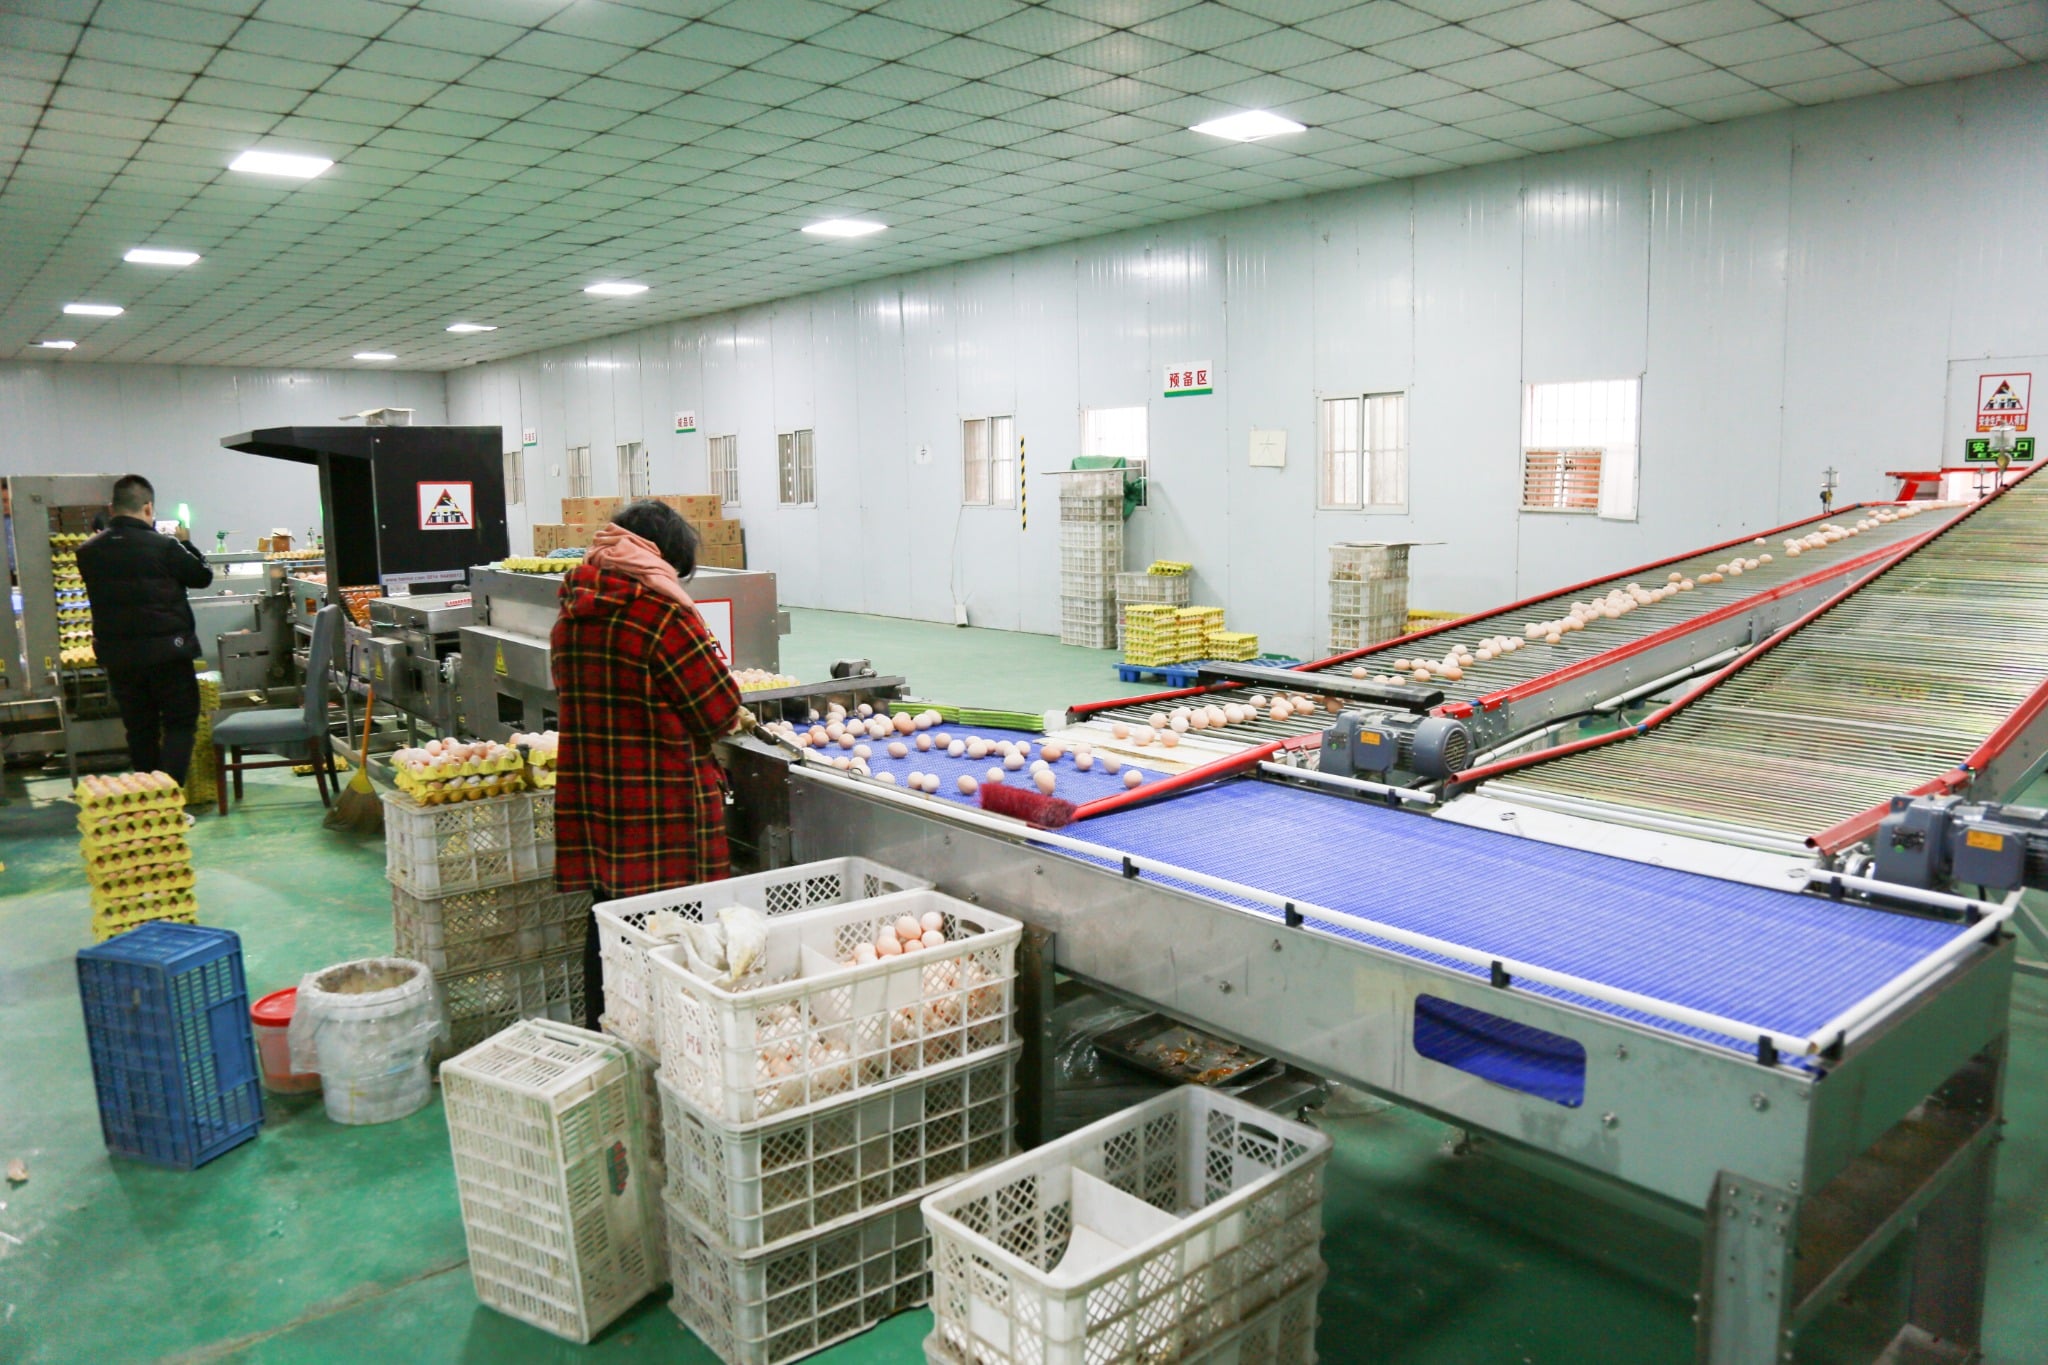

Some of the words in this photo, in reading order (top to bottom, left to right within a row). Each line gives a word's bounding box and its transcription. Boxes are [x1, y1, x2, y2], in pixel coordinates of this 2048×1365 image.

[1169, 370, 1207, 388] 预备区
[1972, 442, 2029, 453] 安口
[1977, 451, 2023, 459] EXT
